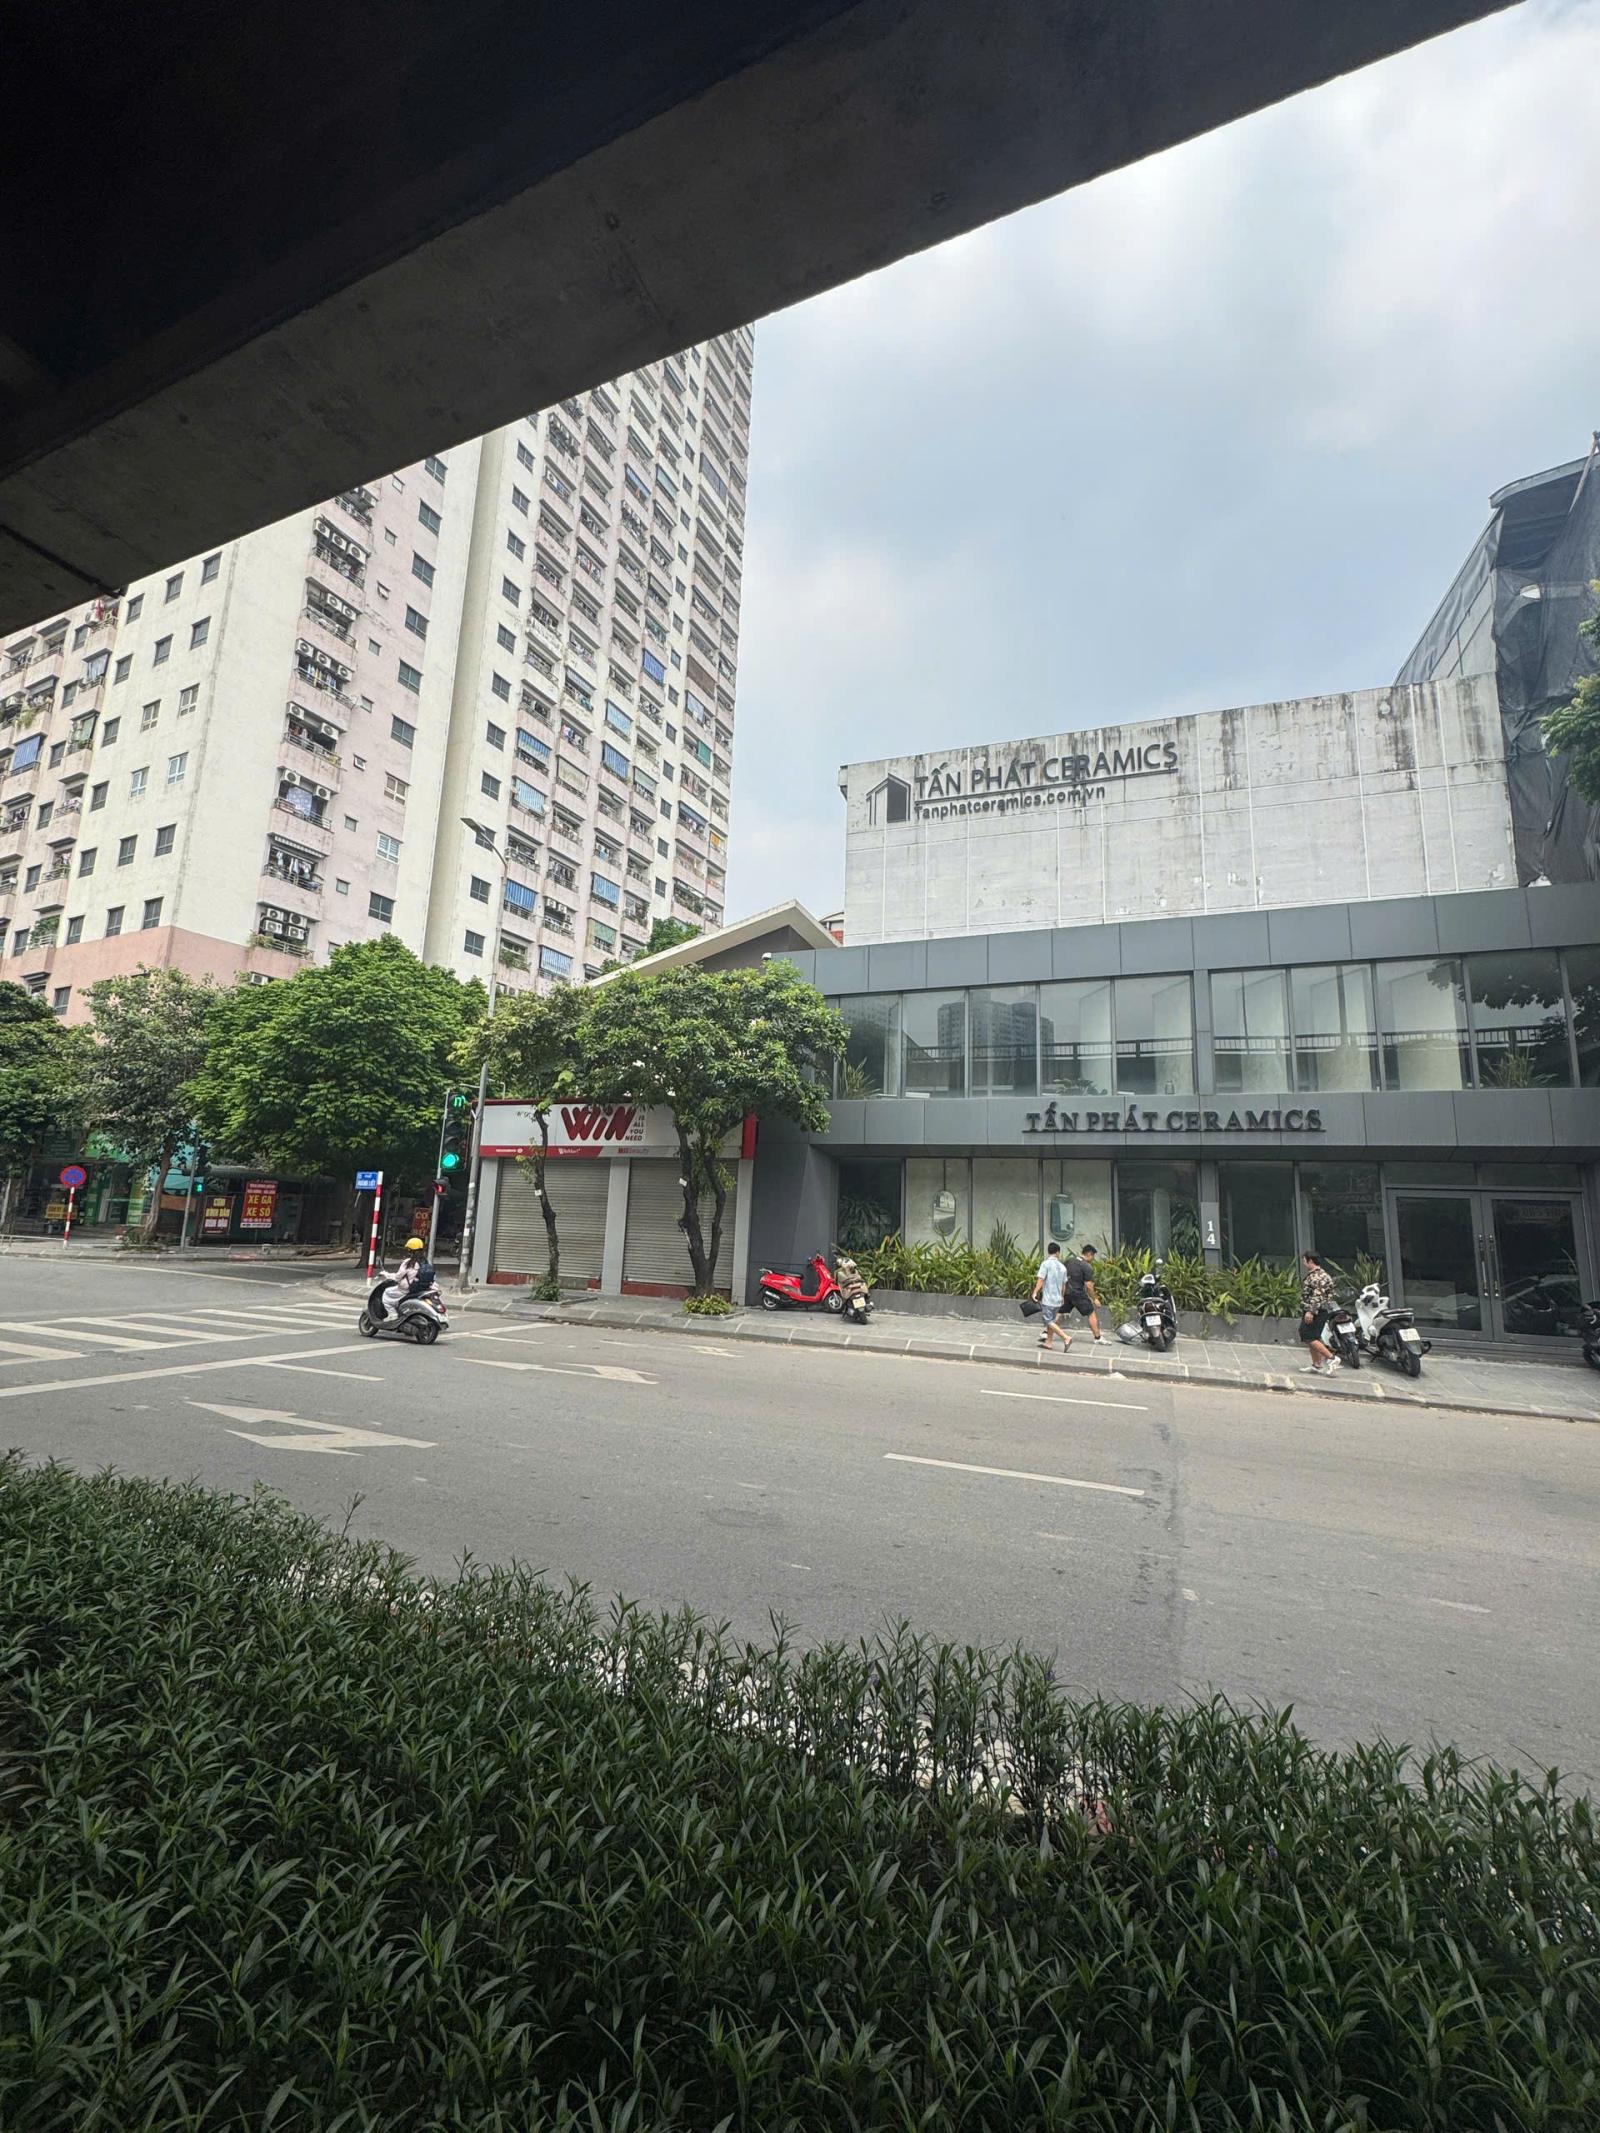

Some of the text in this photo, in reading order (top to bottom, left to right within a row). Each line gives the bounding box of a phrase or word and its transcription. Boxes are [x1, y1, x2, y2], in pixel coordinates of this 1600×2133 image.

[914, 741, 1177, 798] TẤN PHÁT CERAMICS
[1026, 1101, 1322, 1131] TẤN PHÁT CERAMICS
